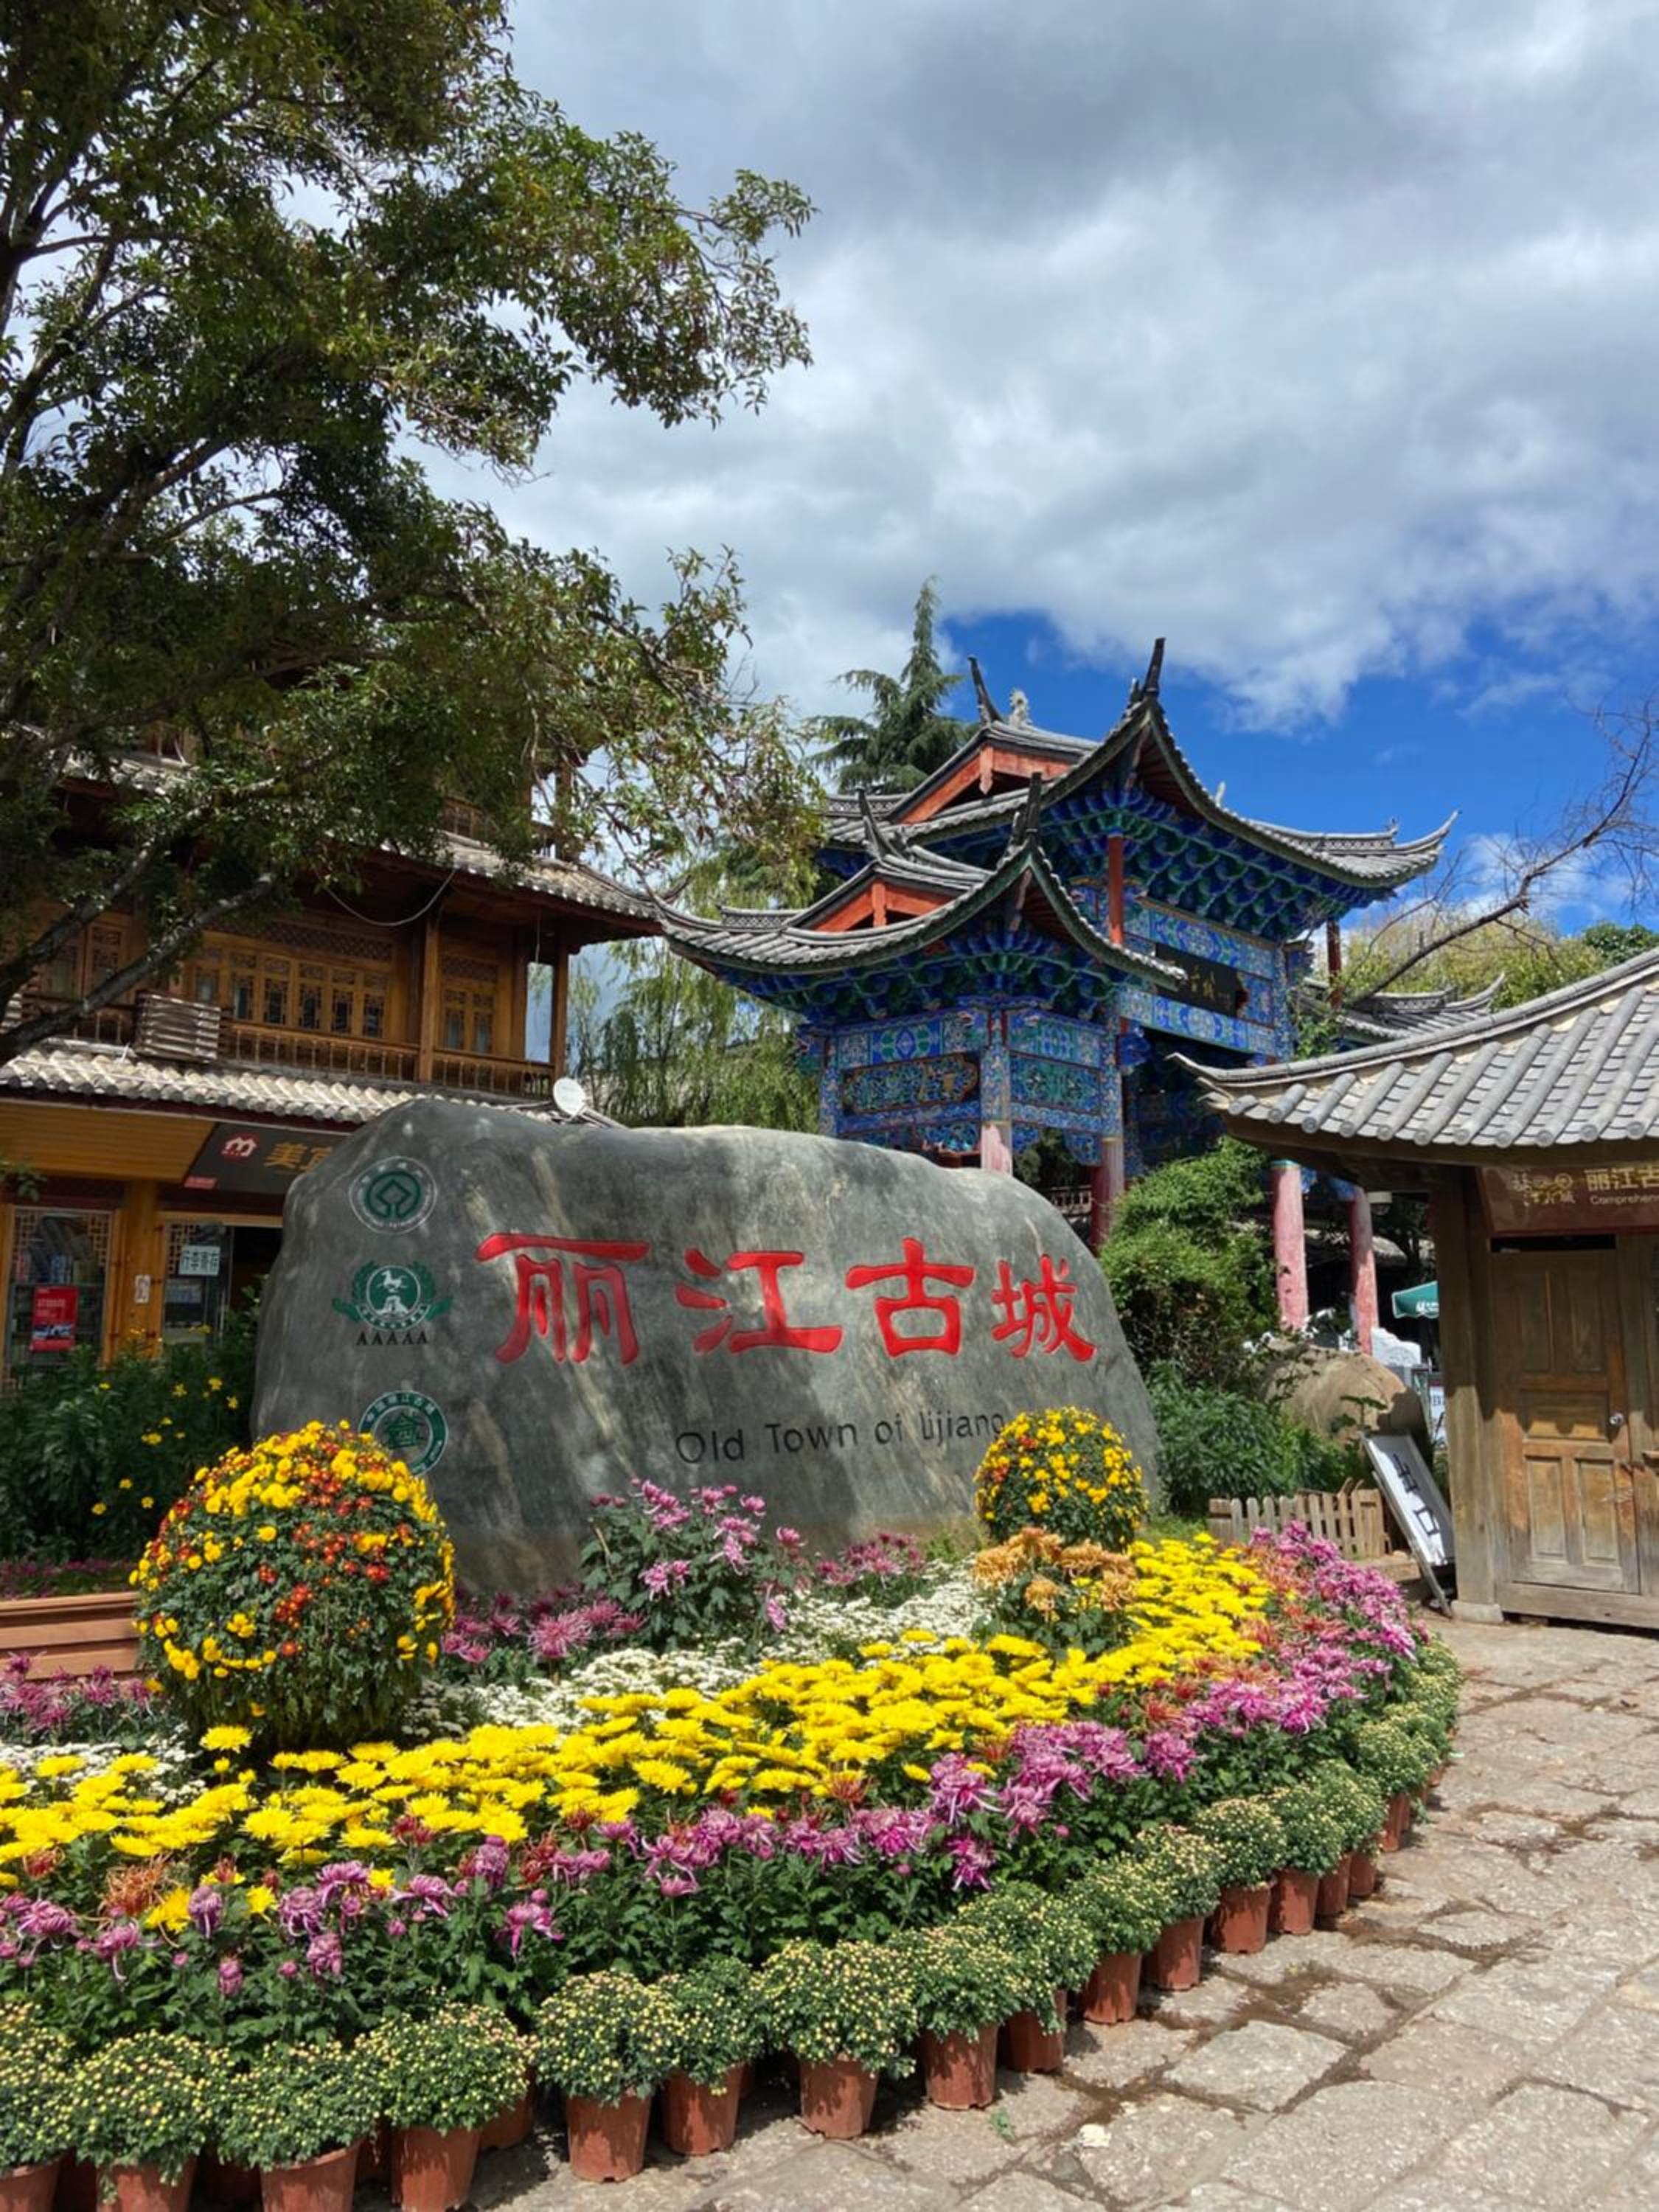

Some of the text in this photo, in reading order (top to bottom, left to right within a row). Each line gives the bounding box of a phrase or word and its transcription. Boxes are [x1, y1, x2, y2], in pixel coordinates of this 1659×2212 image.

[476, 1231, 1097, 1366] 丽江古城
[356, 1331, 428, 1346] AAAAA
[675, 1429, 745, 1464] Old
[765, 1422, 858, 1453] Town
